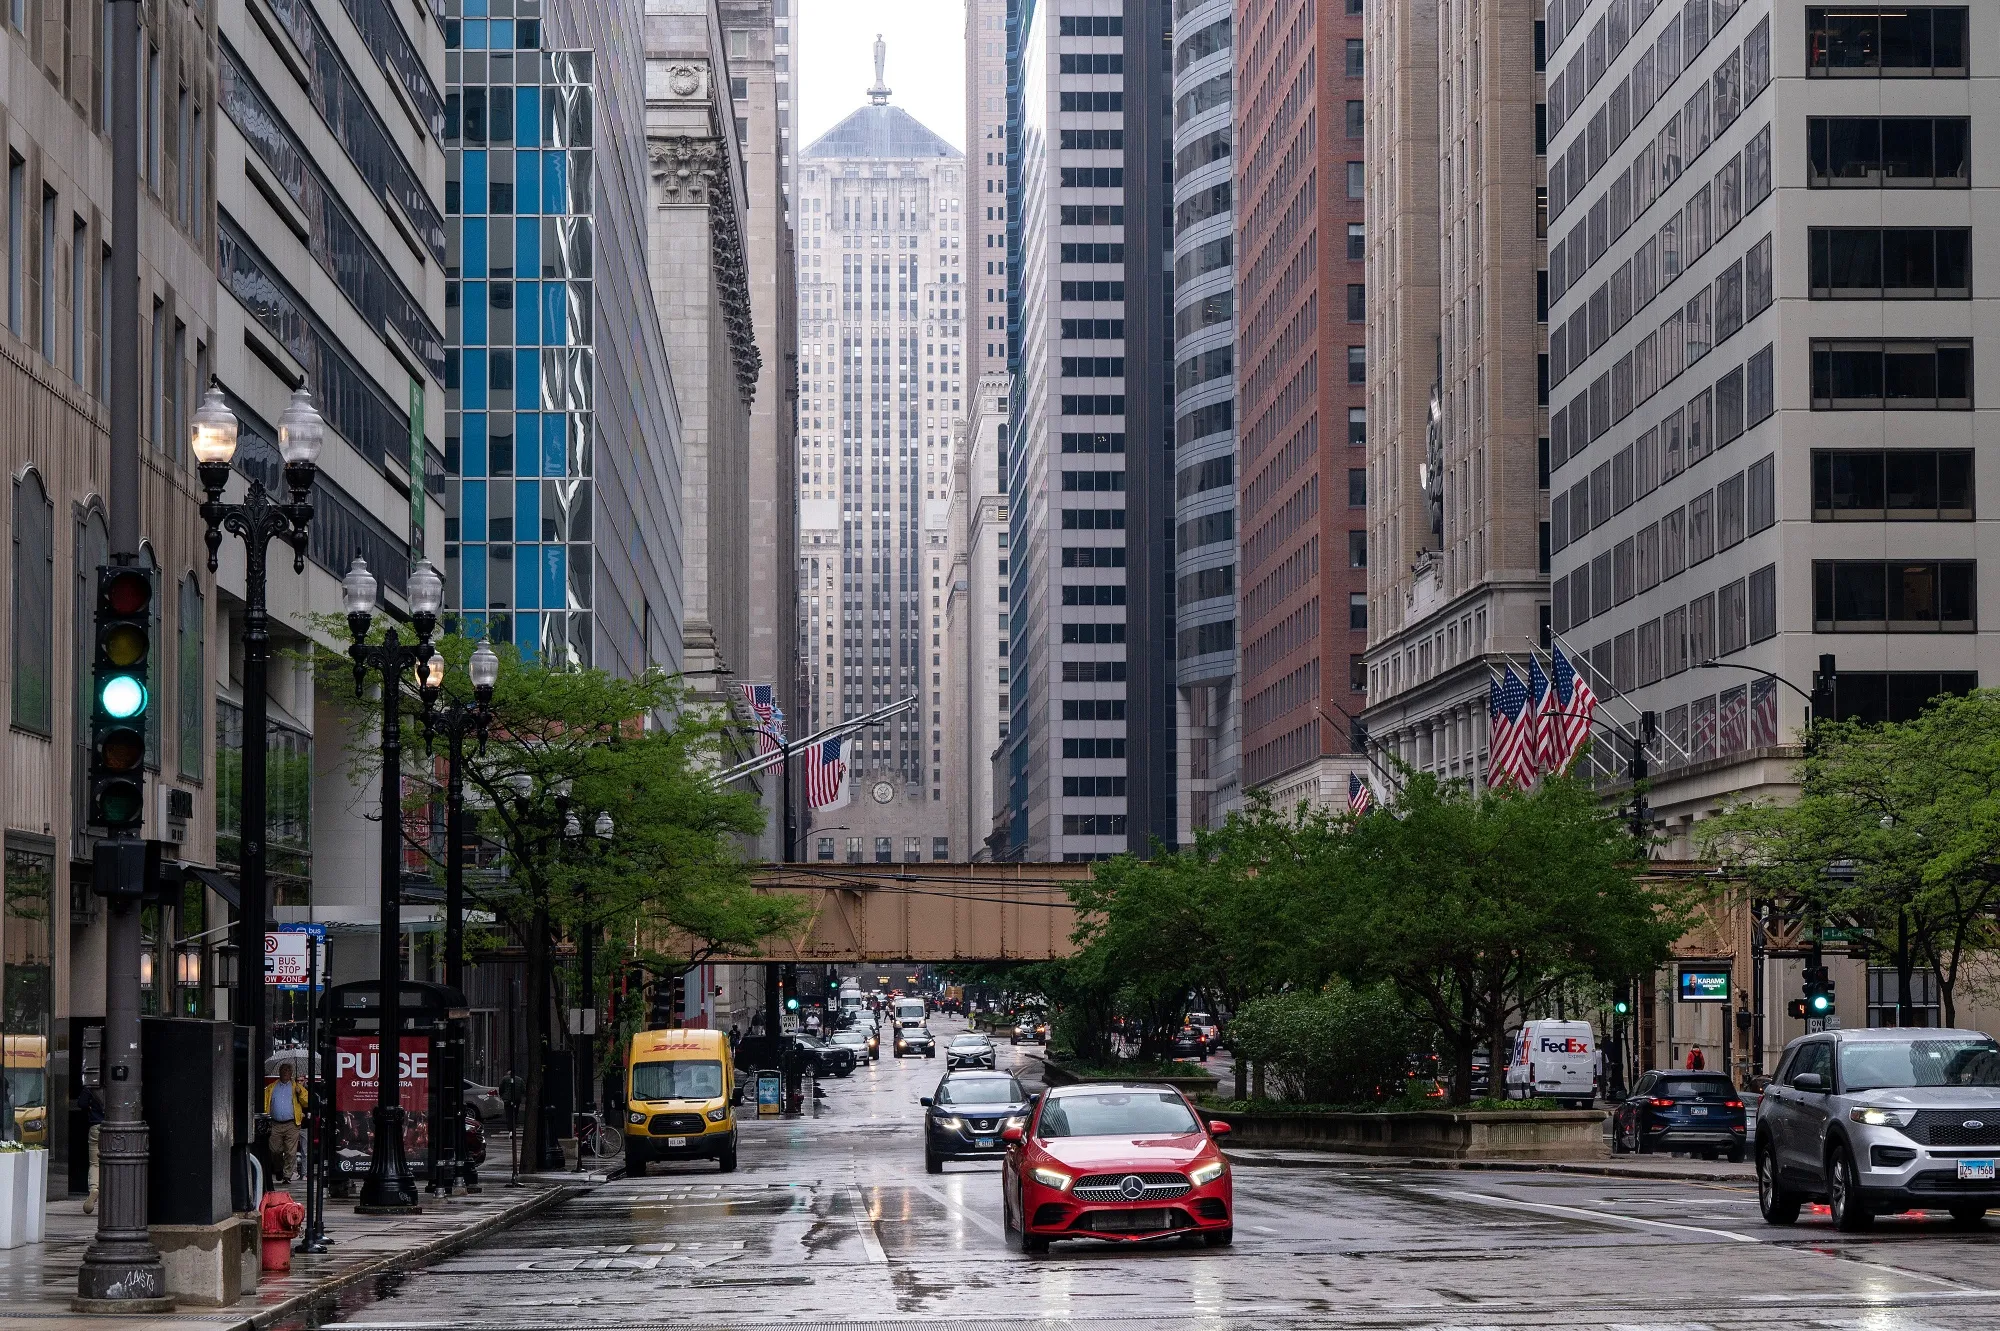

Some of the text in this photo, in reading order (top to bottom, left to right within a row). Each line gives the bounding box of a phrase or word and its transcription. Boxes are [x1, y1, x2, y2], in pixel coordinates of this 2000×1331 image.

[824, 817, 865, 825] CHICAGO
[868, 817, 897, 825] BOARD
[902, 817, 912, 825] OF
[278, 957, 296, 965] BUS
[278, 966, 300, 974] STOP
[1799, 1005, 1805, 1013] 4
[652, 1043, 700, 1052] DHL
[1541, 1038, 1588, 1053] FedEx
[336, 1052, 428, 1078] PUSE
[1977, 1166, 1993, 1175] 7568
